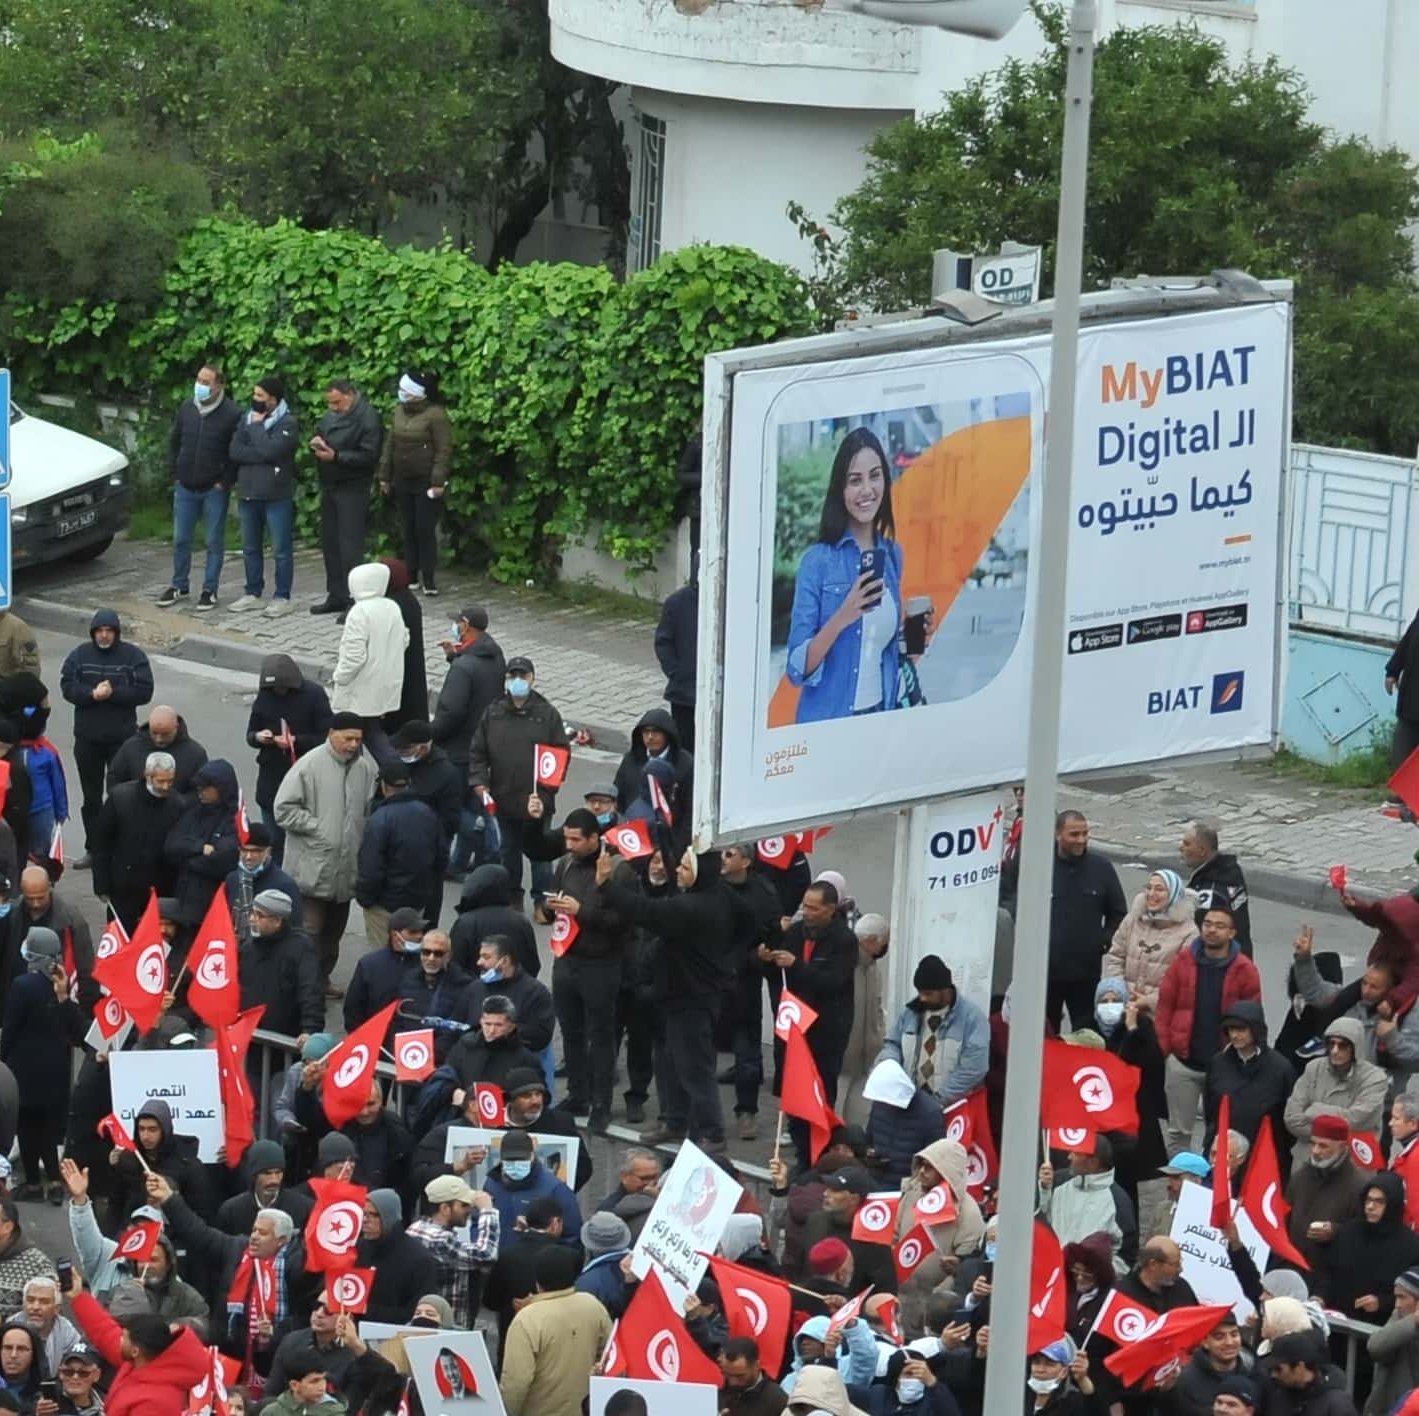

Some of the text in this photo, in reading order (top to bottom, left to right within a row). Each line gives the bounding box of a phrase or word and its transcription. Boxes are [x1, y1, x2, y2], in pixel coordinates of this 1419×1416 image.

[1101, 345, 1256, 409] MyBIAT
[1098, 409, 1220, 471] Digital
[1190, 468, 1253, 519] كيما
[1147, 685, 1204, 714] BIAT
[928, 876, 946, 890] 71
[953, 870, 978, 887] 610
[185, 1107, 216, 1120] عهد
